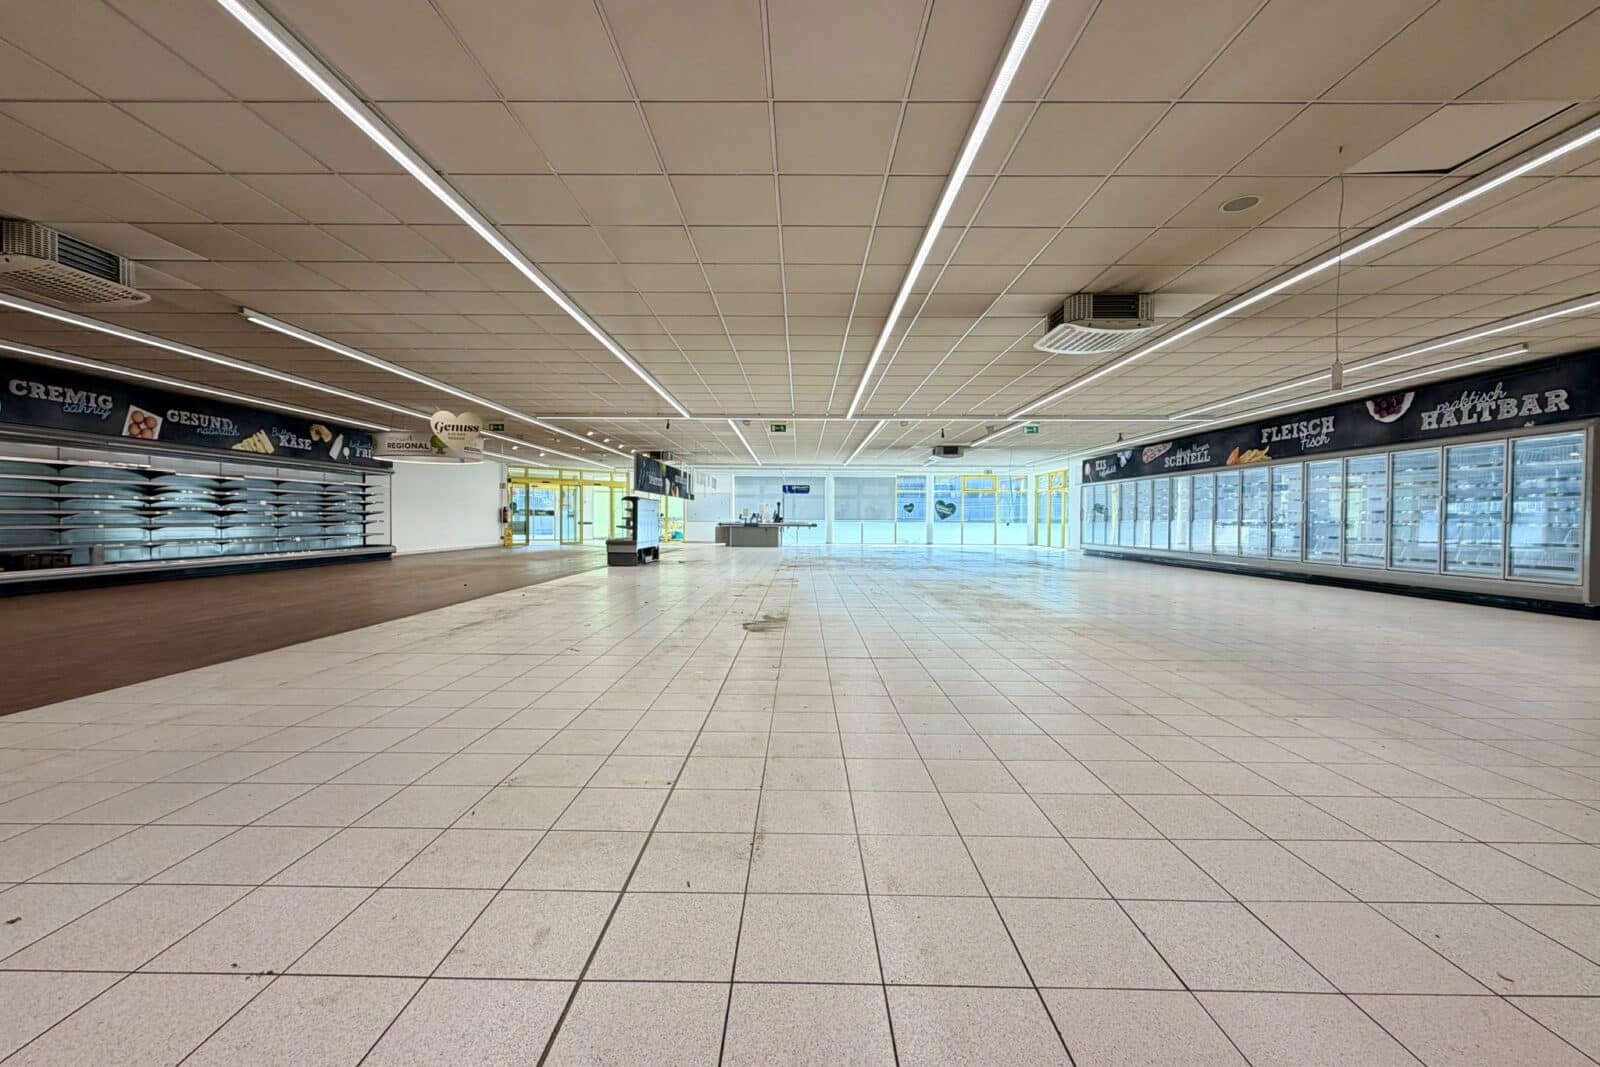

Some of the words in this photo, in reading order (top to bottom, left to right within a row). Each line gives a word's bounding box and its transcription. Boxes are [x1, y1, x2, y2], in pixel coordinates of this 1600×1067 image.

[8, 379, 113, 410] CREMIG
[1437, 382, 1507, 413] praktisch
[167, 409, 233, 429] GESUND
[1421, 389, 1570, 430] HALTBAR
[434, 422, 480, 433] Genuss
[1261, 416, 1335, 443] FLEISCH
[279, 434, 312, 450] KÄSE
[387, 442, 430, 450] REGIONAL
[1164, 450, 1210, 468] SCHNELL
